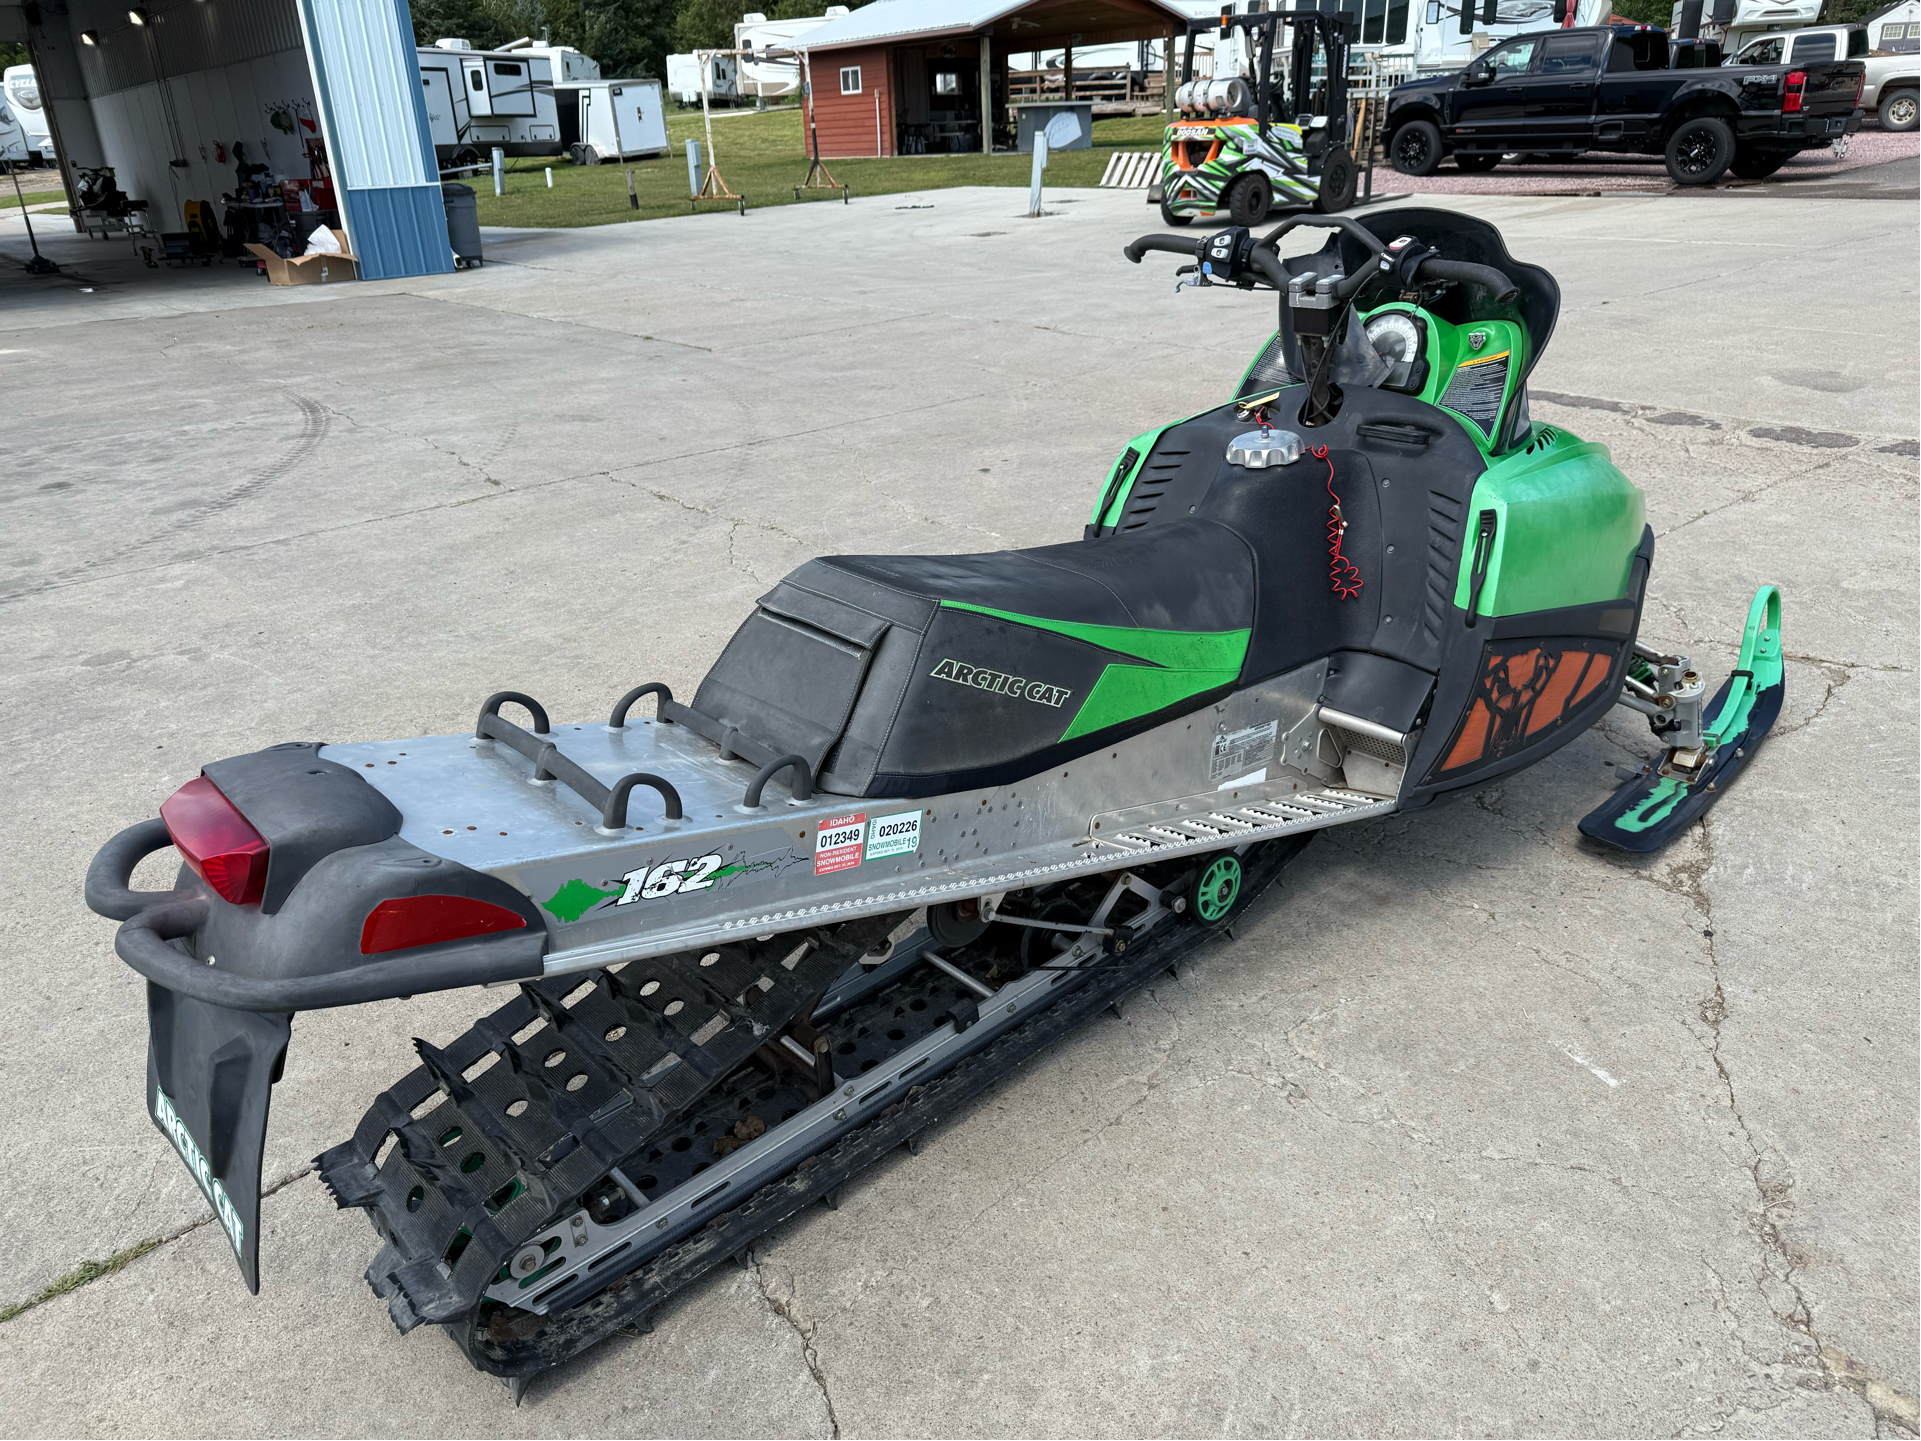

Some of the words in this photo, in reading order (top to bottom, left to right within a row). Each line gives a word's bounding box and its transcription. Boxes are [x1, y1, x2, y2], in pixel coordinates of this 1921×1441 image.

[1743, 74, 1777, 85] FX4
[1177, 128, 1209, 136] DOOSAN
[930, 658, 1026, 698] ARCTIC
[1026, 681, 1073, 708] CAT
[829, 815, 855, 827] IDAHO
[879, 820, 918, 837] 020226
[820, 829, 860, 848] 012349
[868, 838, 907, 851] SNOWMOBILE
[906, 836, 918, 849] 19
[820, 846, 857, 858] NON-RESIDENT
[816, 852, 860, 867] SNOWMOBILE
[614, 855, 723, 907] 162
[155, 1085, 212, 1201] ARCTIC
[212, 1178, 244, 1258] CAT
